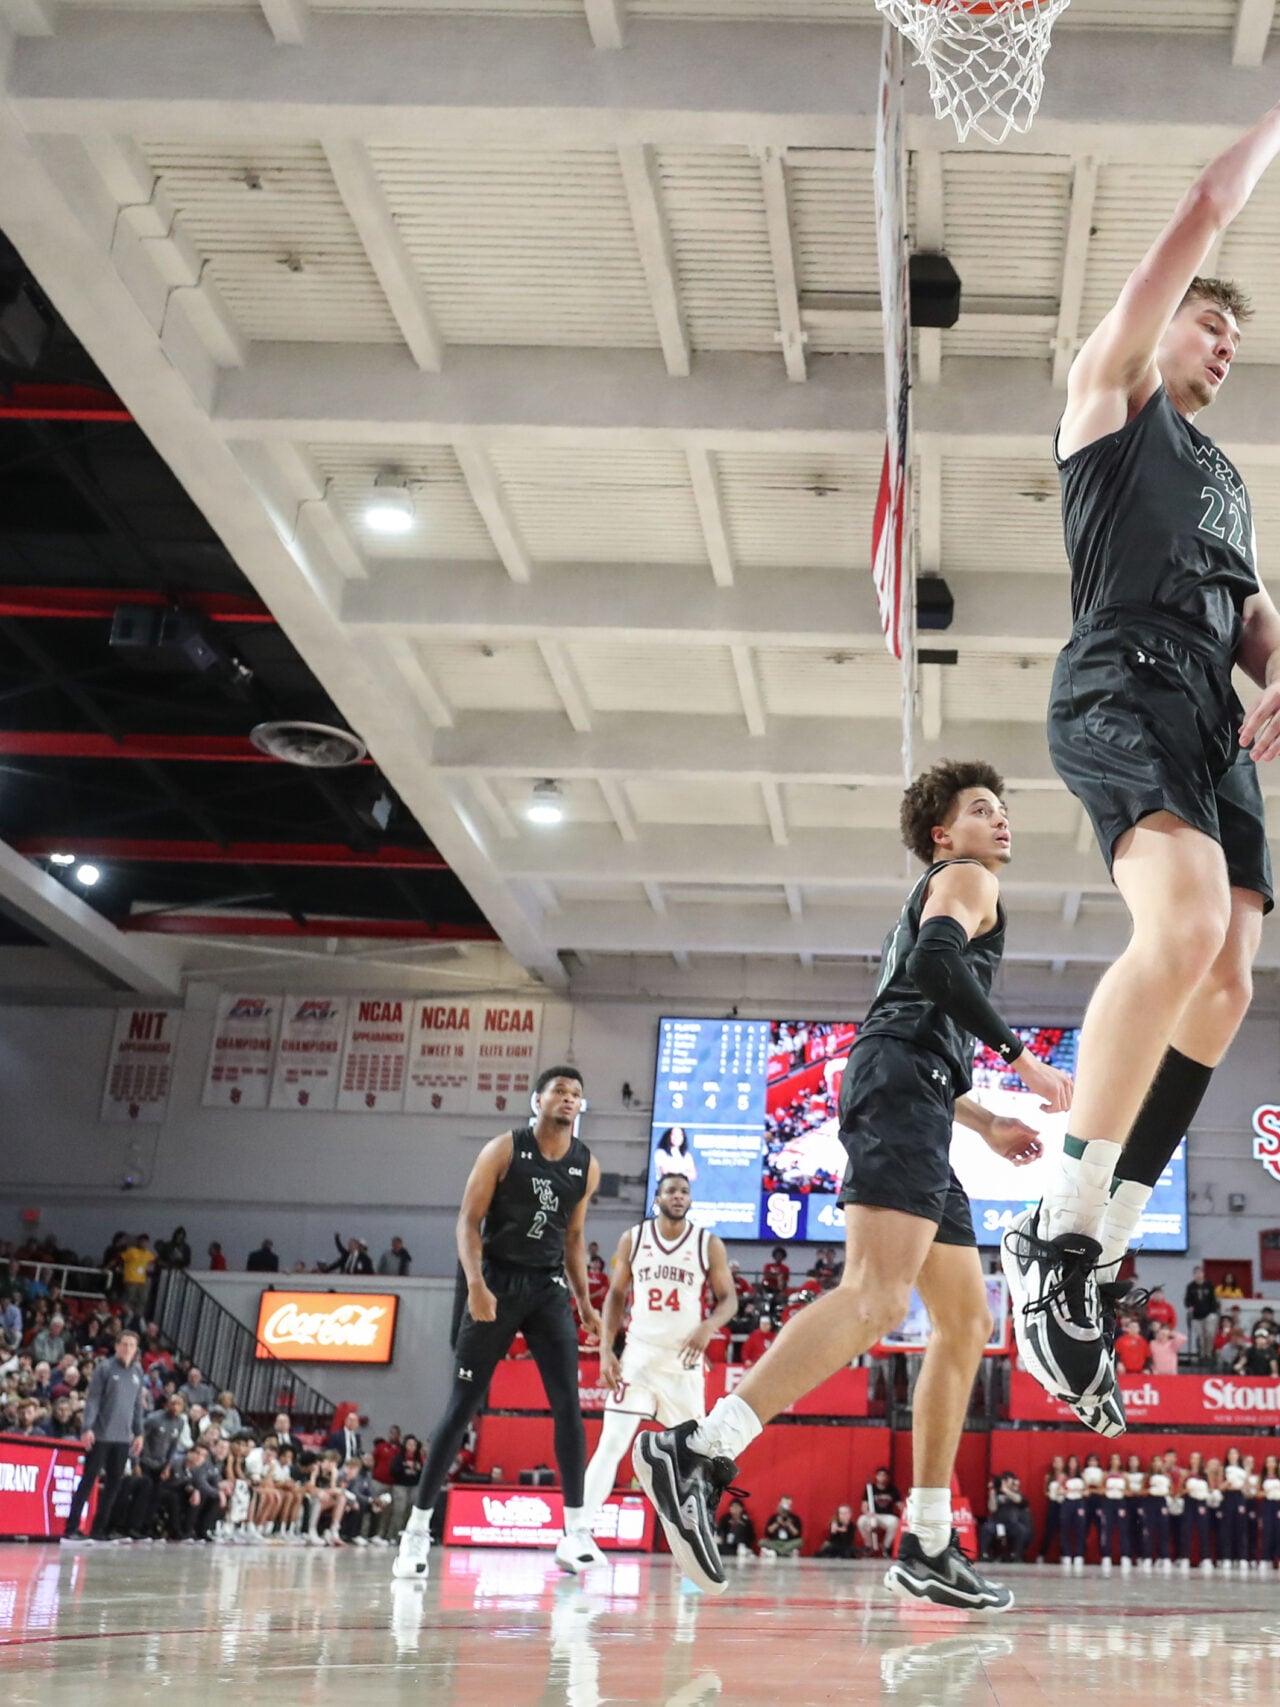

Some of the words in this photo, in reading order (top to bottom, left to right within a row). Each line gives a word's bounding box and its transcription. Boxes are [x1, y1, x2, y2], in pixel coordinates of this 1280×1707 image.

[1198, 486, 1247, 559] 22
[358, 1002, 402, 1023] NCAA
[420, 1007, 470, 1030] NCAA
[484, 1009, 534, 1032] NCAA
[128, 1011, 168, 1040] NIT
[215, 1037, 271, 1050] CHAMPIONS
[281, 1040, 338, 1052] CHAMPIONS
[421, 1044, 451, 1057] SWEET
[454, 1045, 464, 1057] 16
[480, 1045, 503, 1057] ELITE
[506, 1046, 533, 1057] EIGHT
[672, 1093, 684, 1110] 3
[704, 1092, 717, 1110] 4
[737, 1094, 749, 1111] 5
[526, 1211, 547, 1239] 2
[654, 1265, 695, 1286] JOHN'S
[648, 1287, 680, 1312] 24
